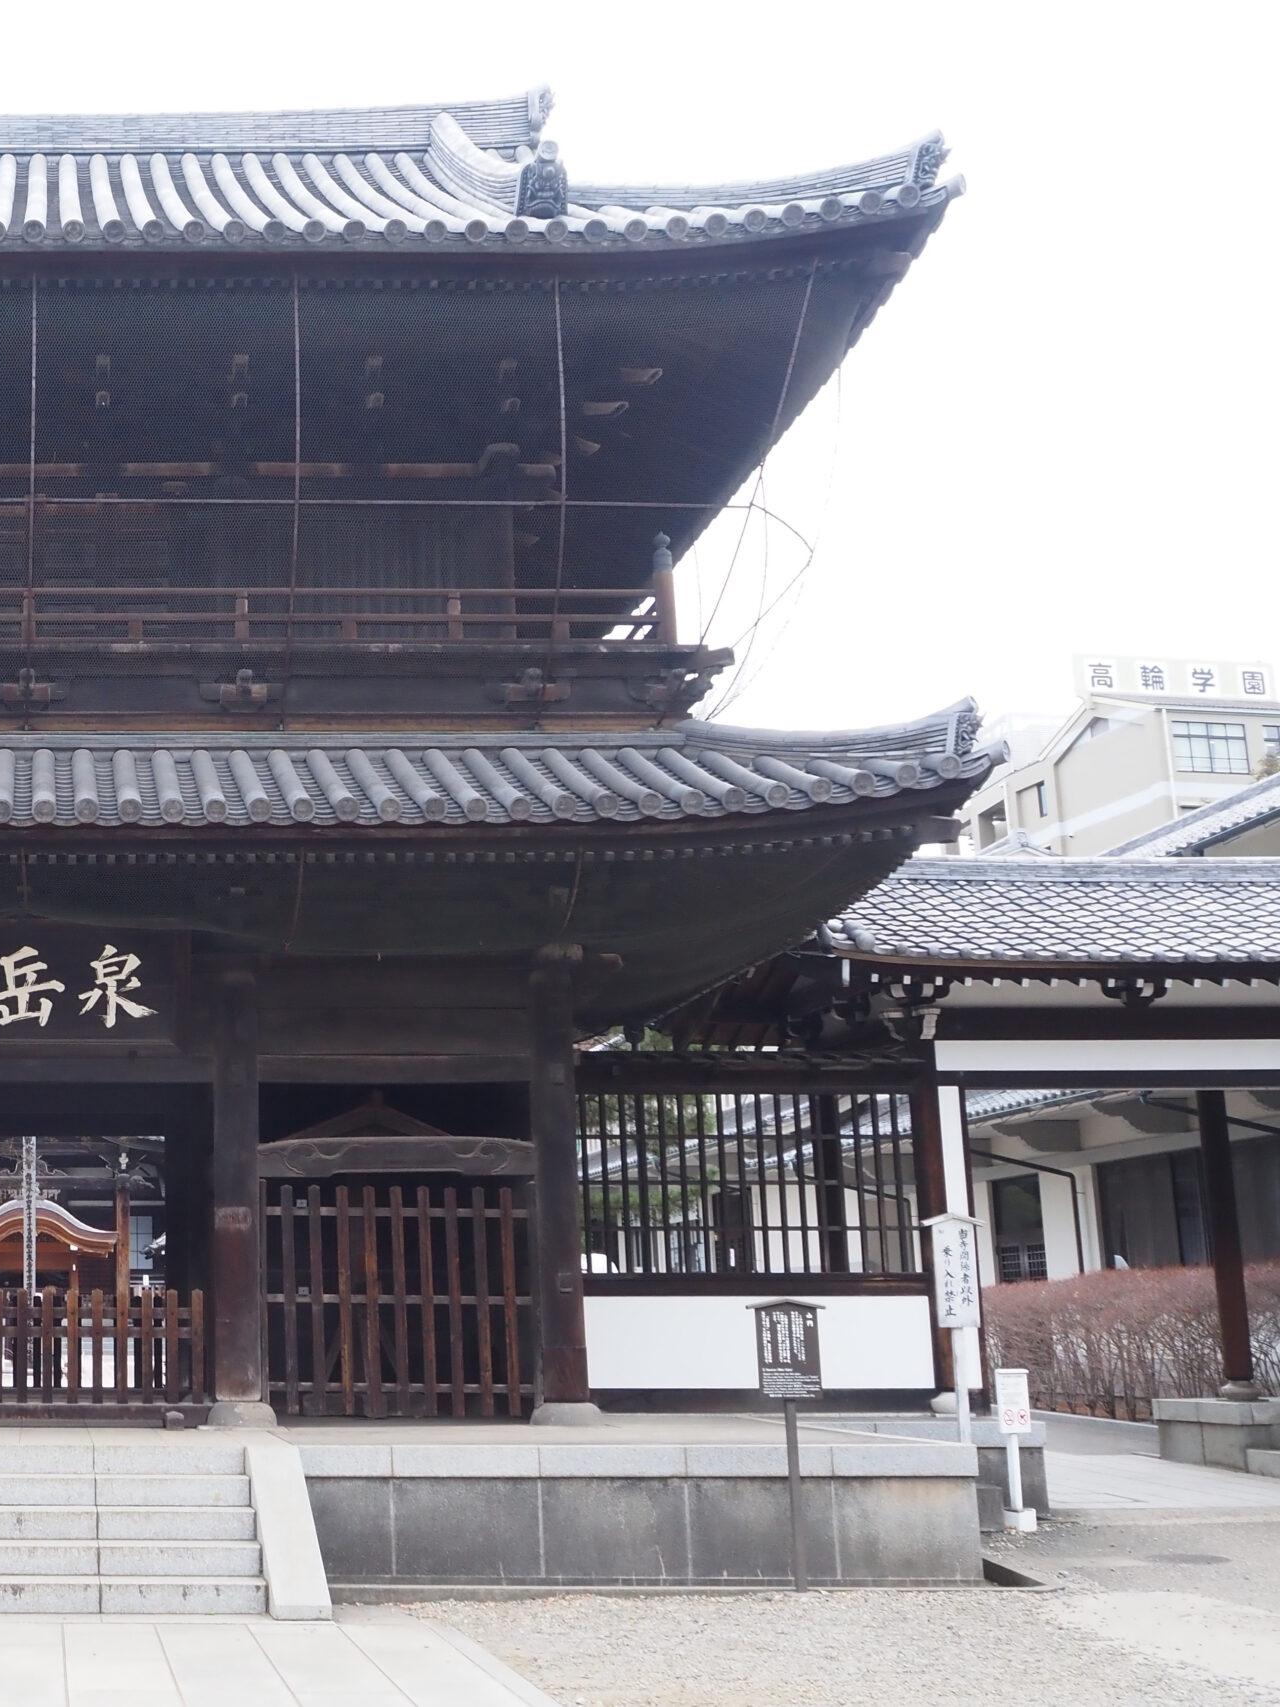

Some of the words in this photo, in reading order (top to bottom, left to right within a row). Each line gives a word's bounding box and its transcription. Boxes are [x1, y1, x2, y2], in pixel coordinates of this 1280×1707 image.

[1088, 662, 1266, 695] 高輪学園
[942, 1245, 957, 1317] 乗り入れ禁止
